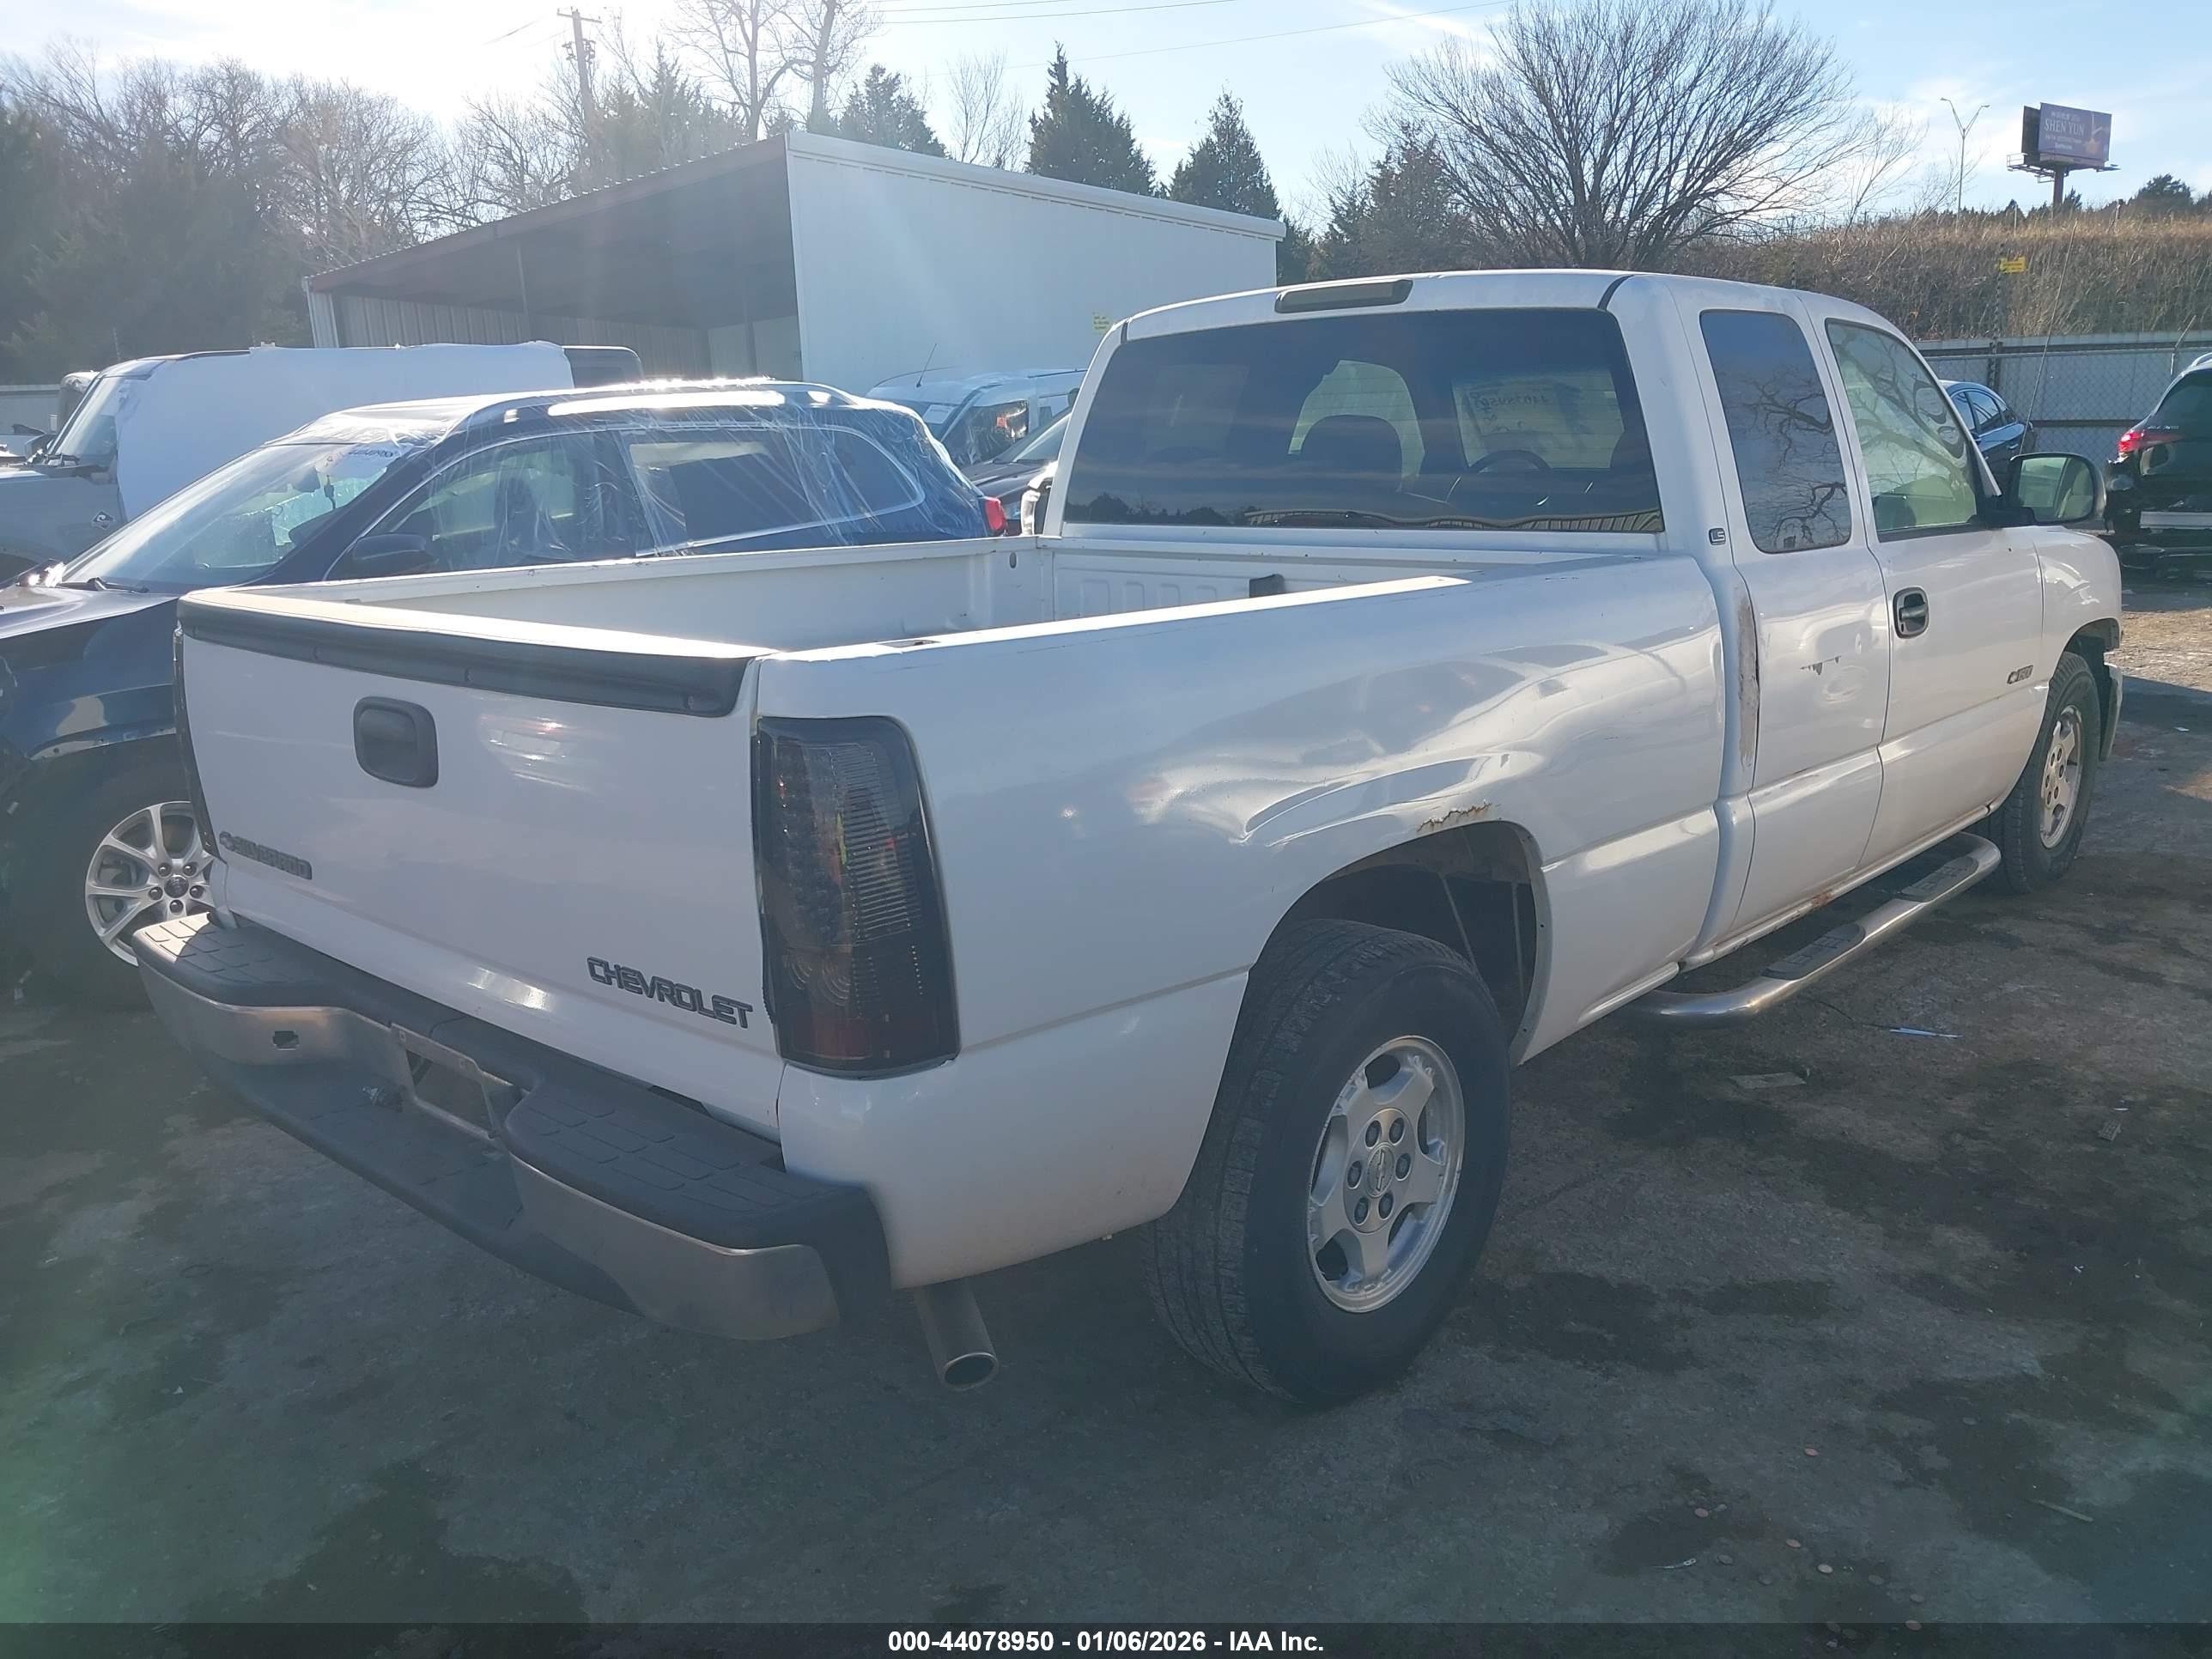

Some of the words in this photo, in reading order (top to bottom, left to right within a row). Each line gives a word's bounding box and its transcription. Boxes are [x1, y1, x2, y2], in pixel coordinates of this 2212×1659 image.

[2045, 118, 2066, 133] SHEN
[2068, 122, 2084, 137] YUN
[586, 956, 754, 1029] CHEVROLET
